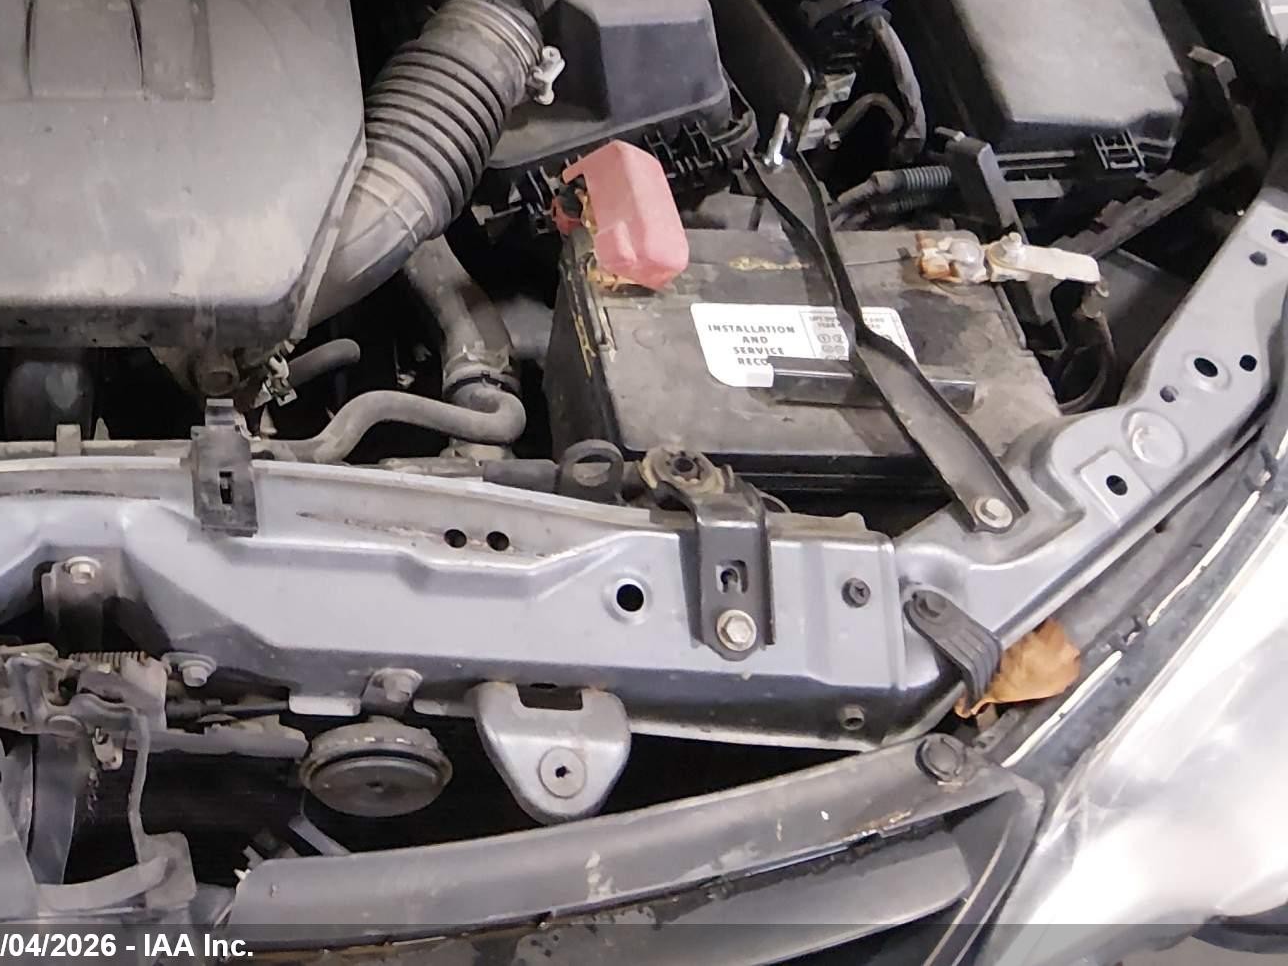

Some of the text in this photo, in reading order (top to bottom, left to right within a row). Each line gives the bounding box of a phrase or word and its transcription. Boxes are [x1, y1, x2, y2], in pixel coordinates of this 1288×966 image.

[707, 324, 796, 334] INSTALLATION
[742, 335, 768, 344] AND
[732, 346, 784, 355] SERVICE
[737, 357, 768, 366] RECO
